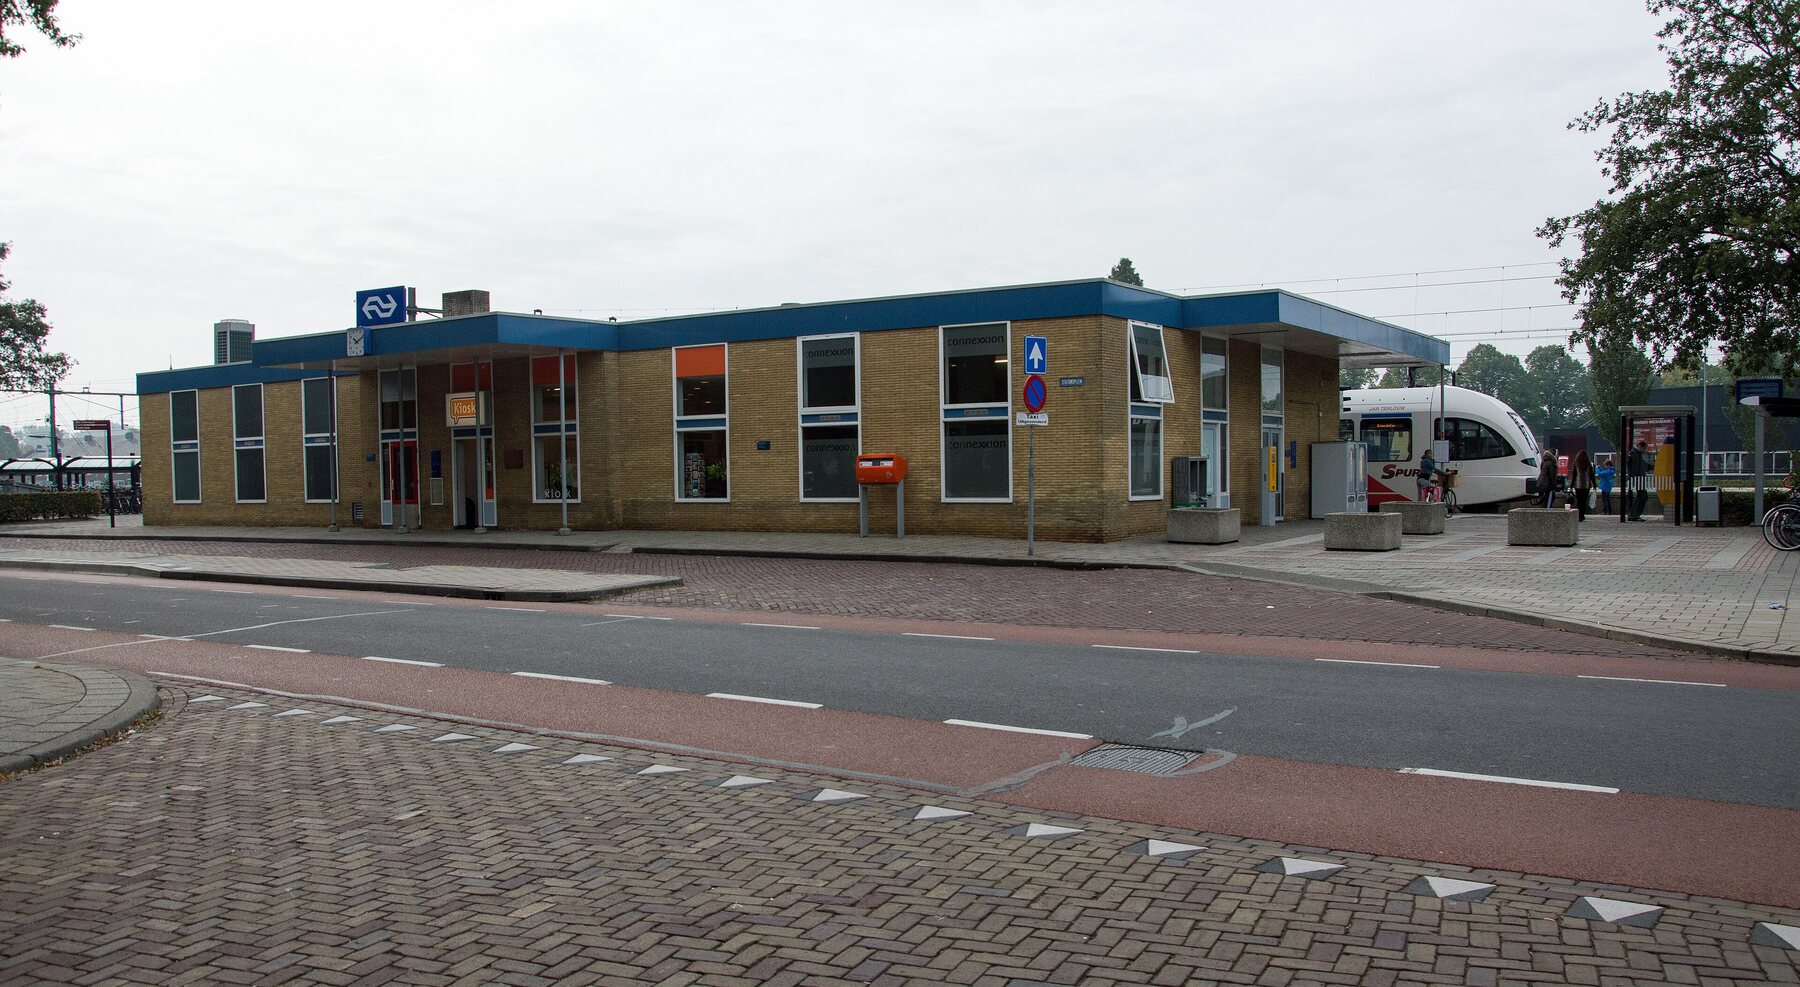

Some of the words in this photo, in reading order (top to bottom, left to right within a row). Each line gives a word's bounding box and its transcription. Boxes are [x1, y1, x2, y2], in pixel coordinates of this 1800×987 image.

[948, 335, 1004, 347] connexxion
[454, 402, 476, 414] Kiosk
[949, 440, 1006, 449] connexxion
[544, 488, 571, 498] kiok
